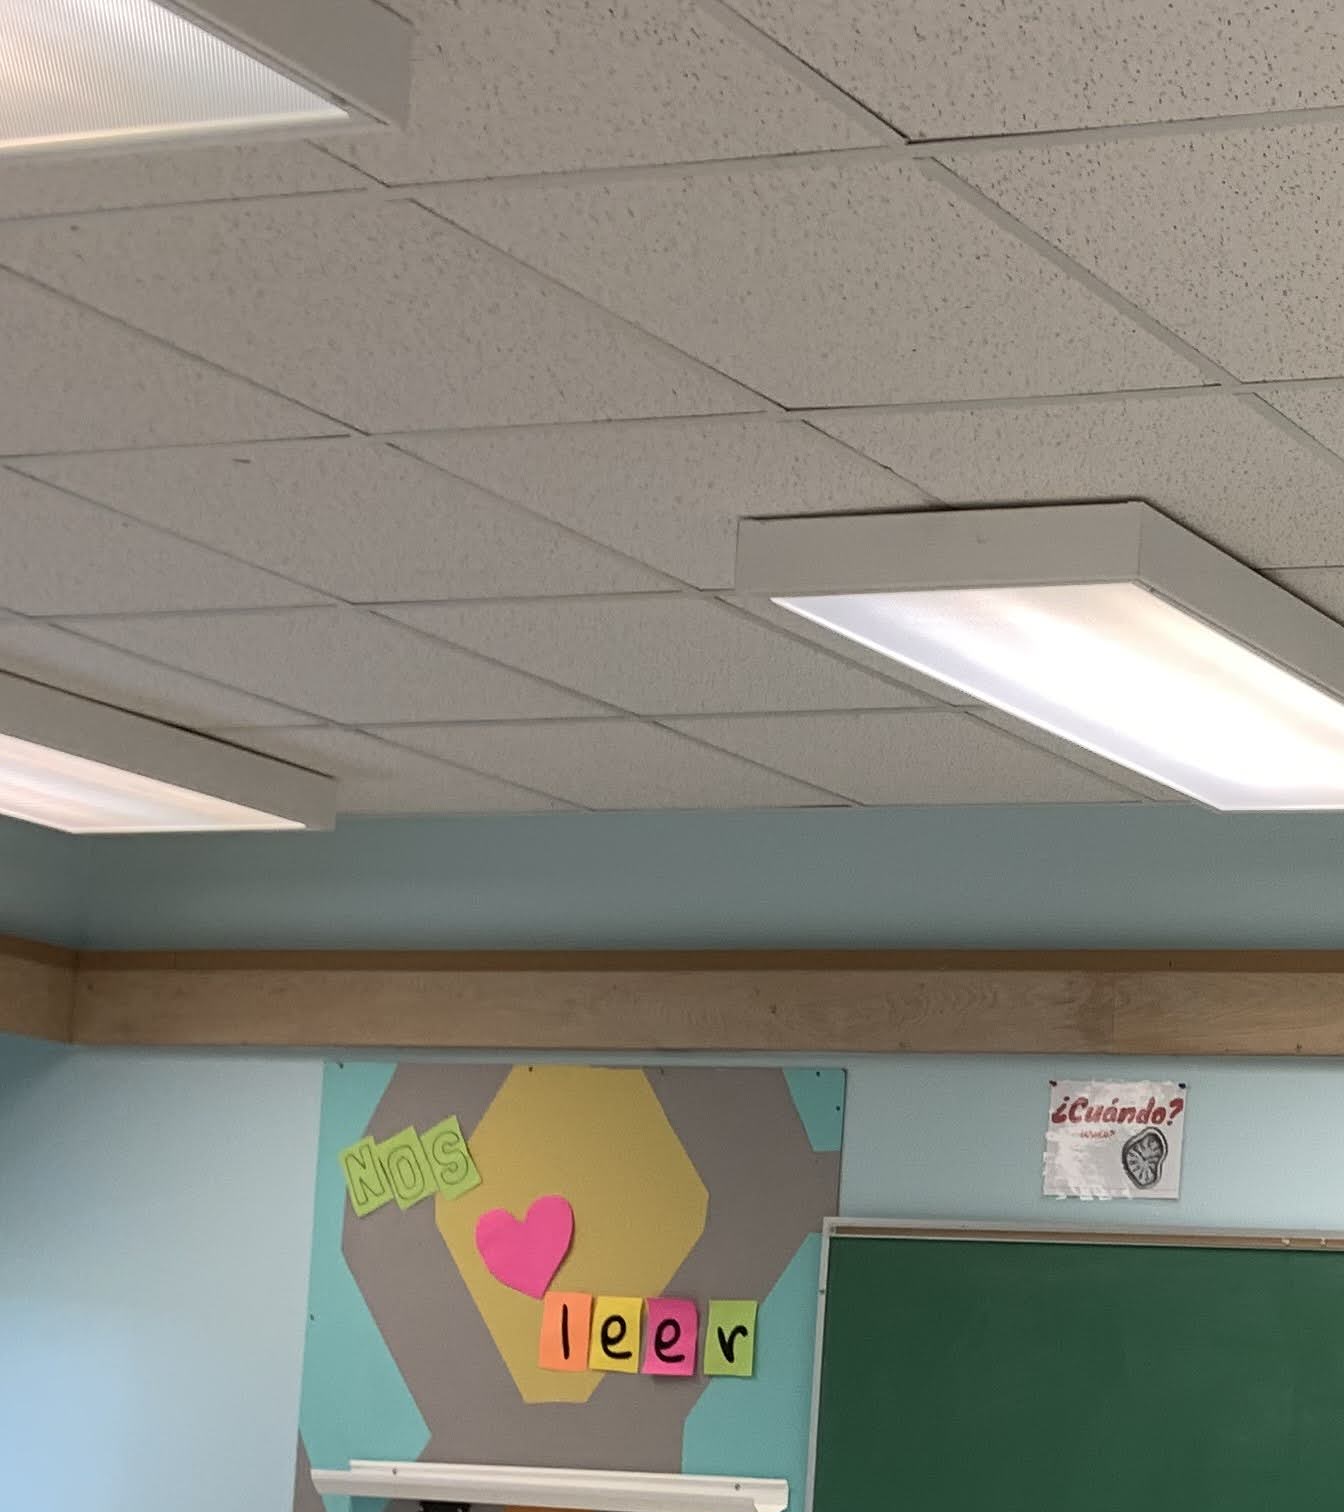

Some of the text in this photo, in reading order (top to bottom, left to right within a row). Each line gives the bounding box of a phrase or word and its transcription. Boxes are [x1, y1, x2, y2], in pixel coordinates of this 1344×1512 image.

[1052, 1096, 1184, 1126] ¿Cuándo?
[345, 1130, 470, 1206] NOS
[560, 1302, 748, 1364] leer
